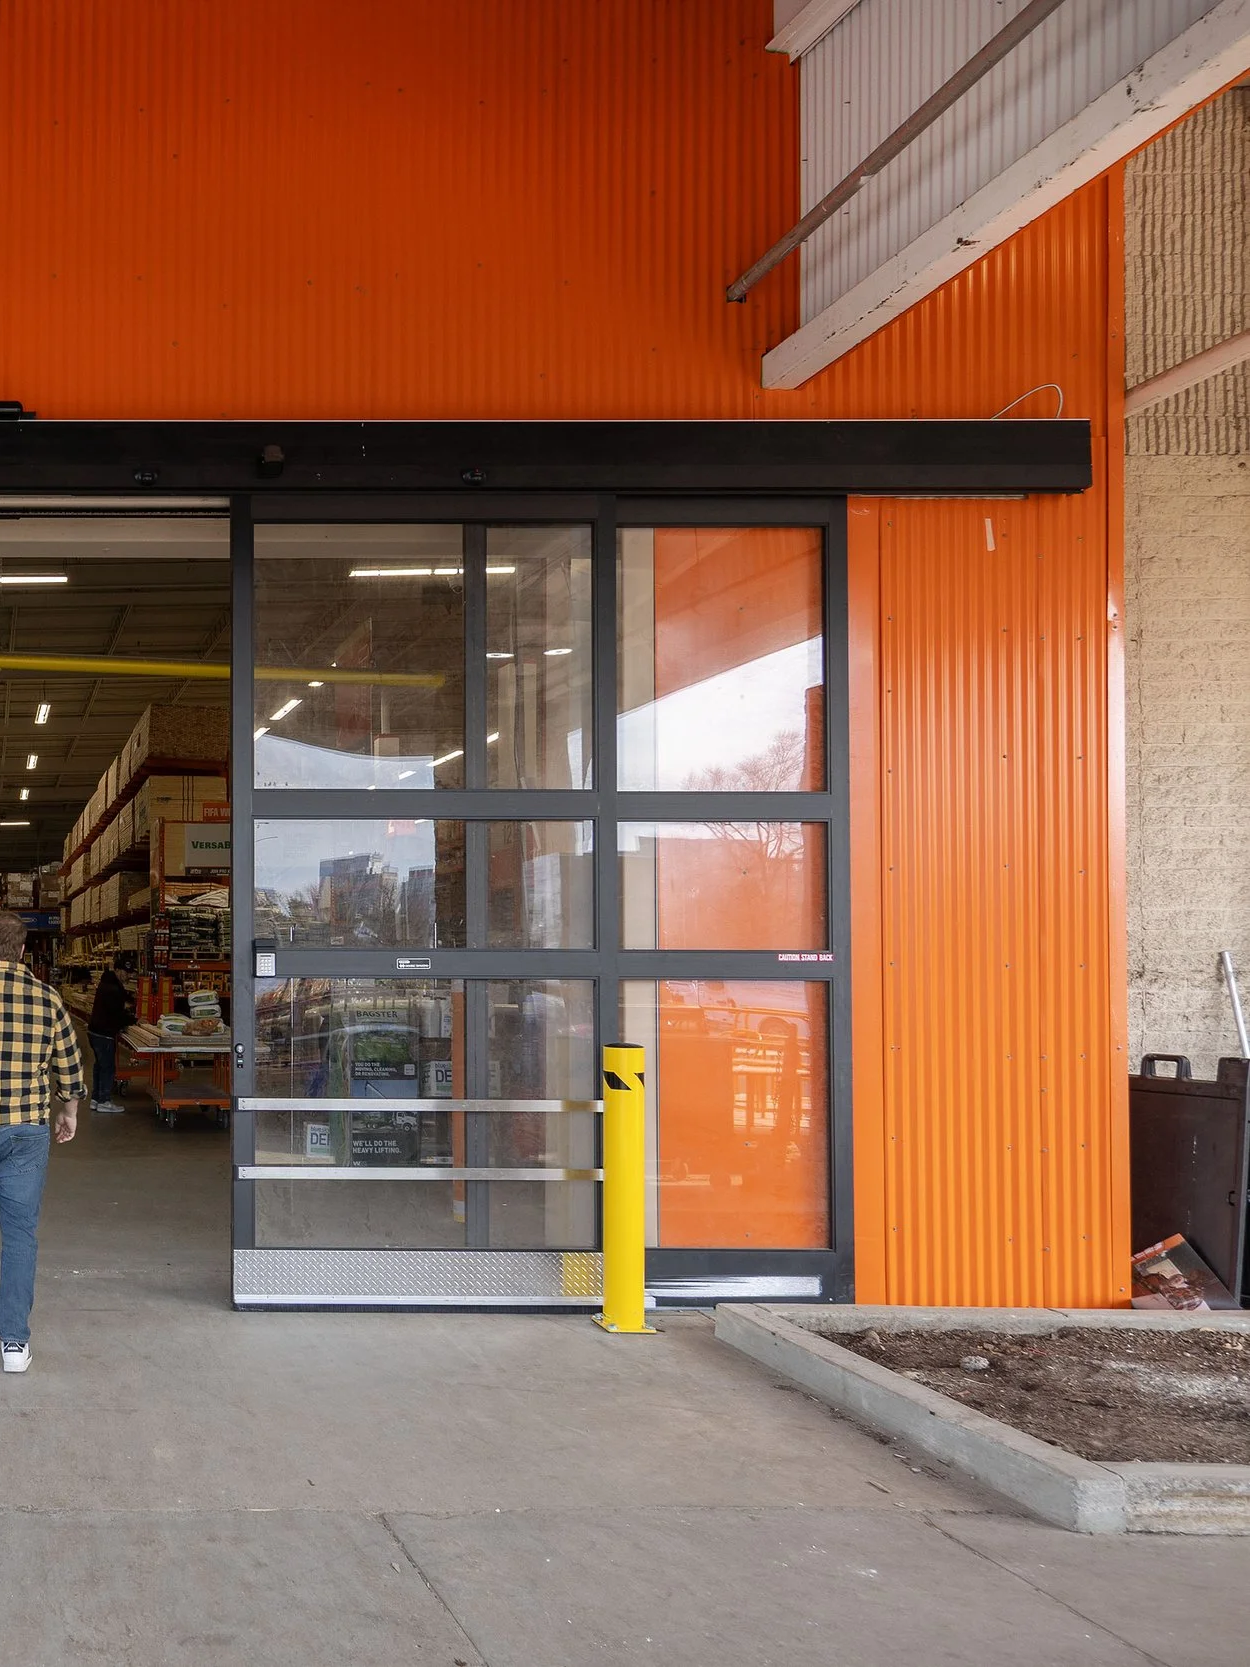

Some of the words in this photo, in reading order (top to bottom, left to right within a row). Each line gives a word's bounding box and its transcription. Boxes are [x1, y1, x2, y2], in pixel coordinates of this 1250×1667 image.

[204, 808, 219, 817] FIFA
[778, 953, 800, 961] CAUTION
[801, 953, 818, 961] STAND
[356, 1010, 398, 1018] BAGSTER
[435, 1070, 452, 1082] DE
